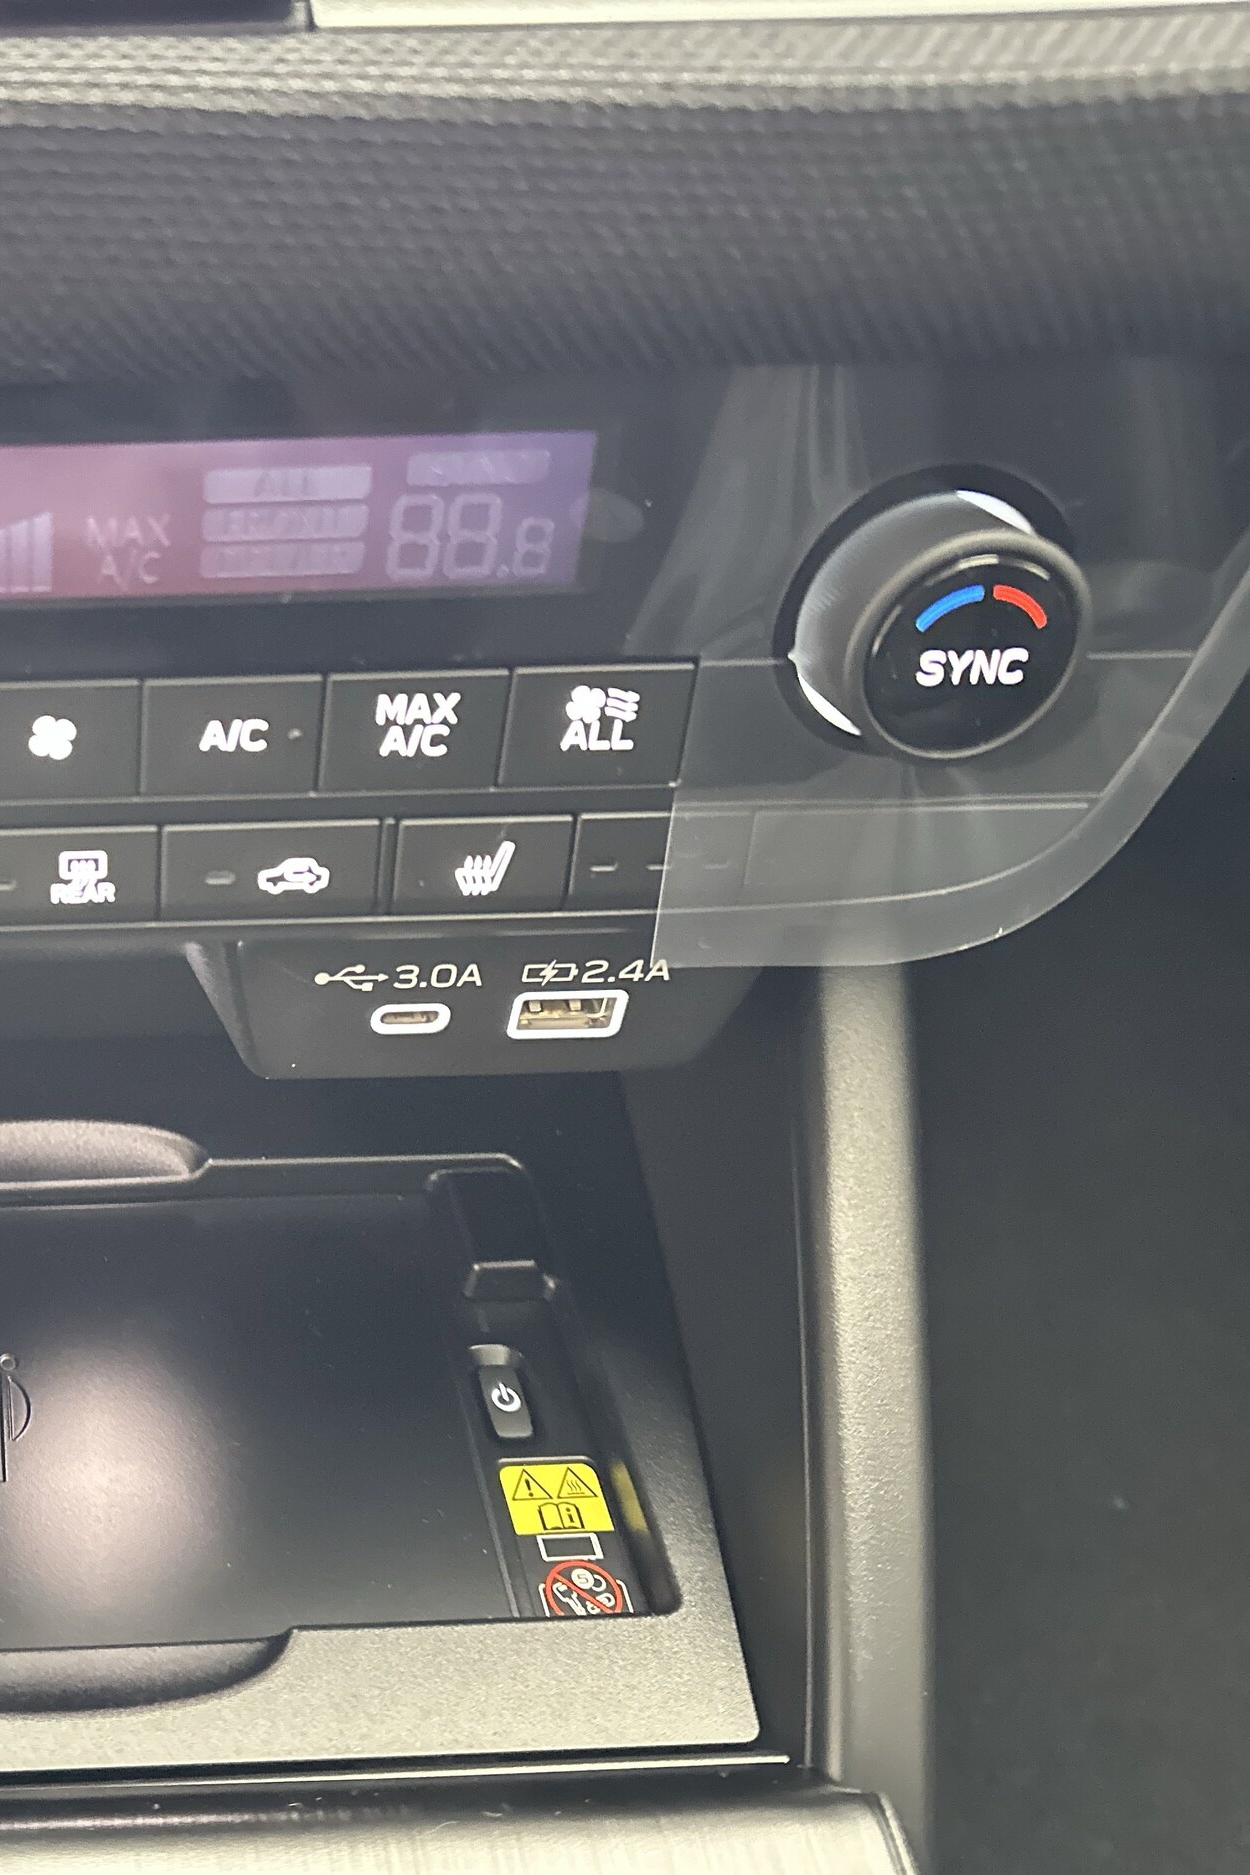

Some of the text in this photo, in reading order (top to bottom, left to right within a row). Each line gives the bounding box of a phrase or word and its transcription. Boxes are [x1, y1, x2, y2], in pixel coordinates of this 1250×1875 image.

[85, 513, 172, 548] MAX
[915, 647, 1029, 687] SYNC
[375, 692, 461, 726] MAX
[198, 719, 270, 753] A/C
[379, 724, 450, 758] A/C
[560, 720, 634, 752] ALL
[50, 881, 116, 904] REAR
[392, 963, 483, 990] 3.0A
[580, 958, 671, 985] 2.4A
